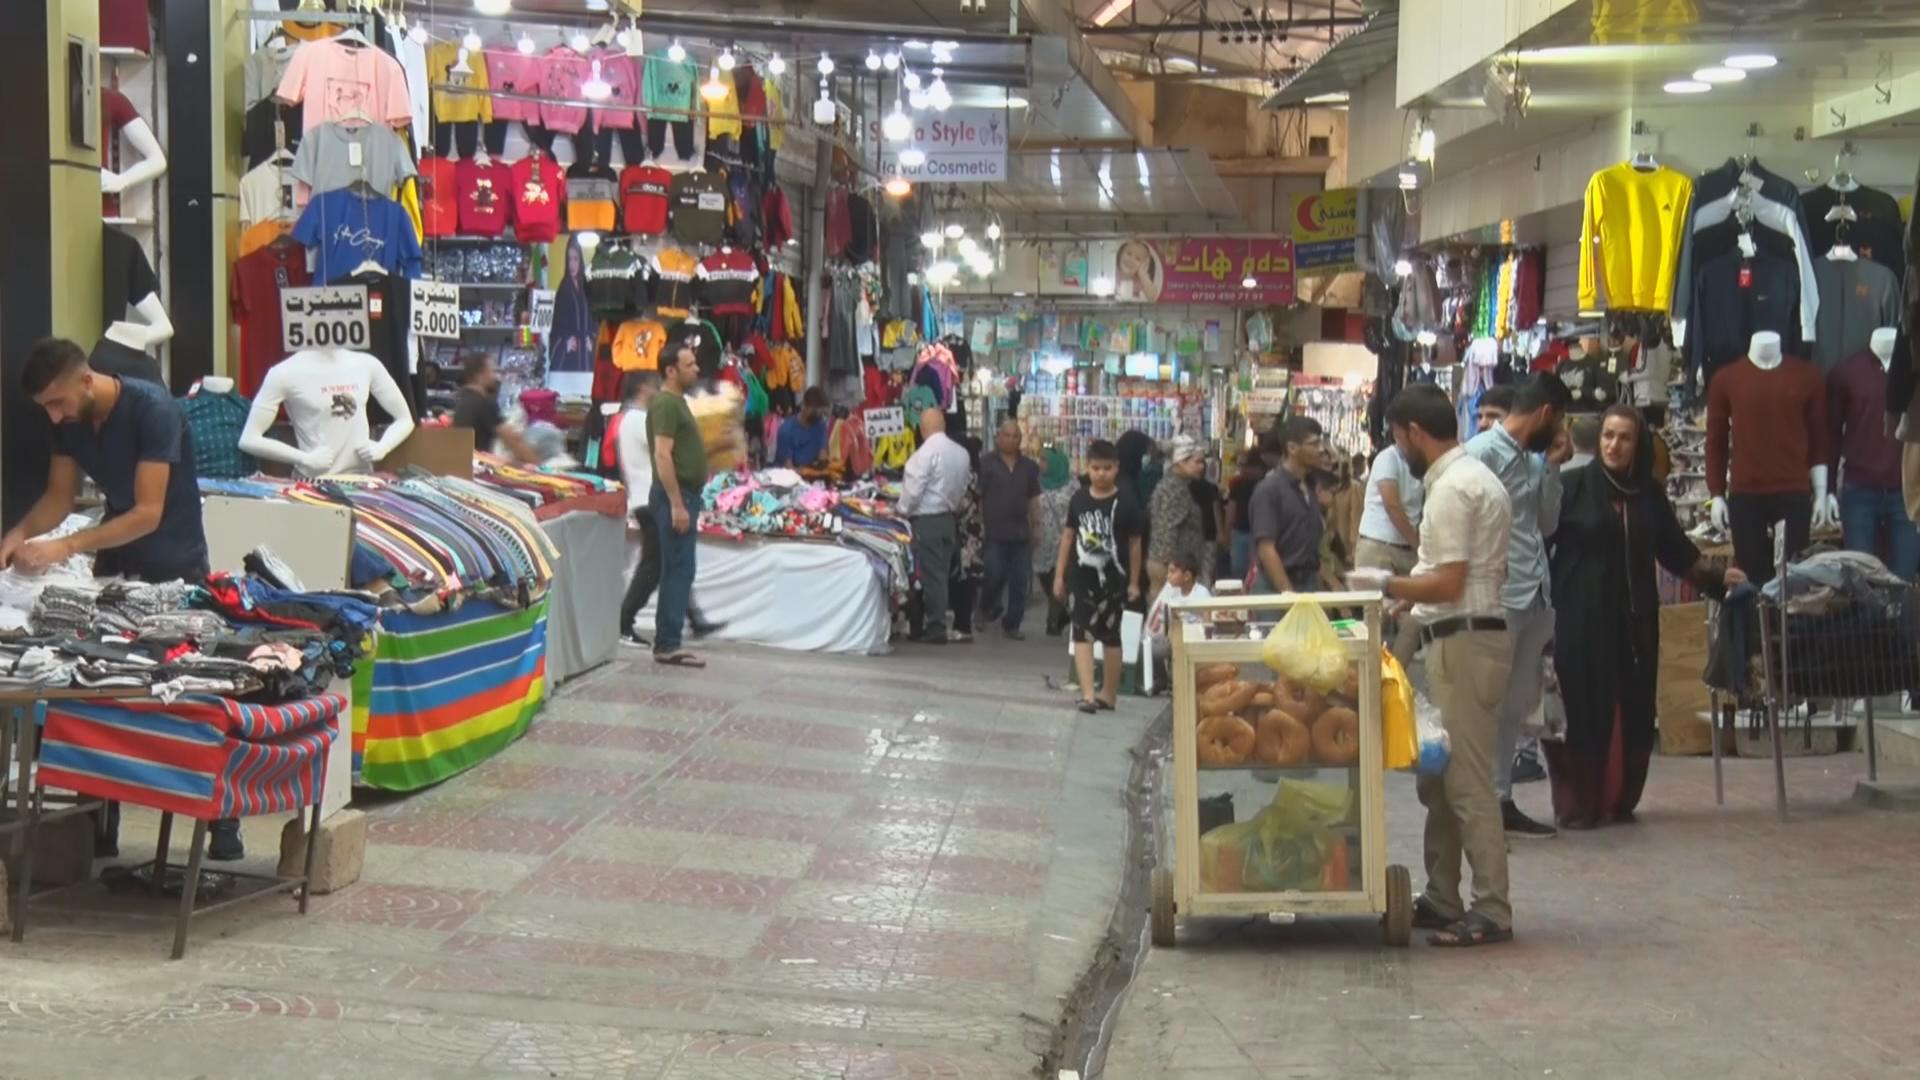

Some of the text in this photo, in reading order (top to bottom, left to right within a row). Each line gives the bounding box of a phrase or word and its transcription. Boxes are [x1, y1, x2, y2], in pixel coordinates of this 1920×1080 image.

[932, 120, 975, 146] Style
[927, 160, 997, 175] Cosmetic
[288, 321, 364, 347] 5.000
[413, 310, 457, 334] 5.000
